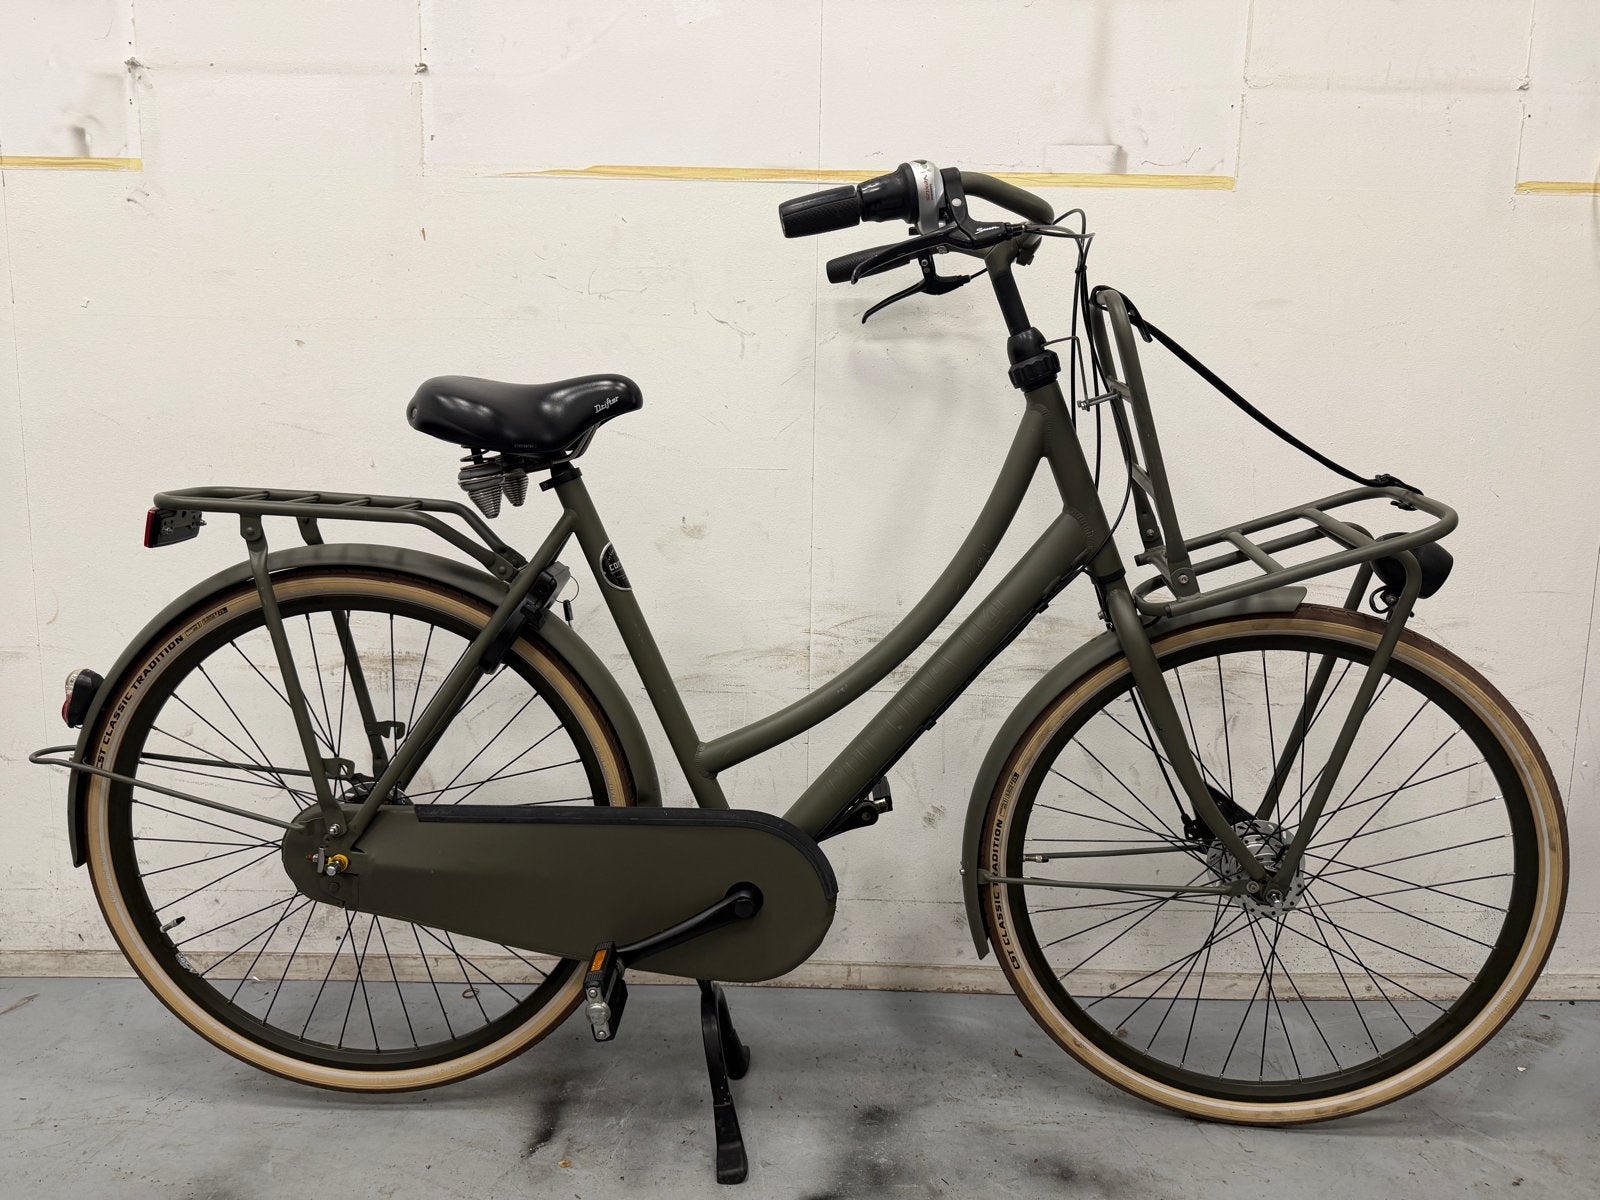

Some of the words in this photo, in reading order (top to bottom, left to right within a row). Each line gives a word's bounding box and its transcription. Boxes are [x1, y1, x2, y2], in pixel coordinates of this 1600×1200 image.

[594, 396, 619, 413] Drifter
[102, 691, 133, 746] CLASSIC
[131, 634, 184, 691] TRADITION
[993, 887, 1011, 946] CLASSIC
[1007, 947, 1020, 970] CST
